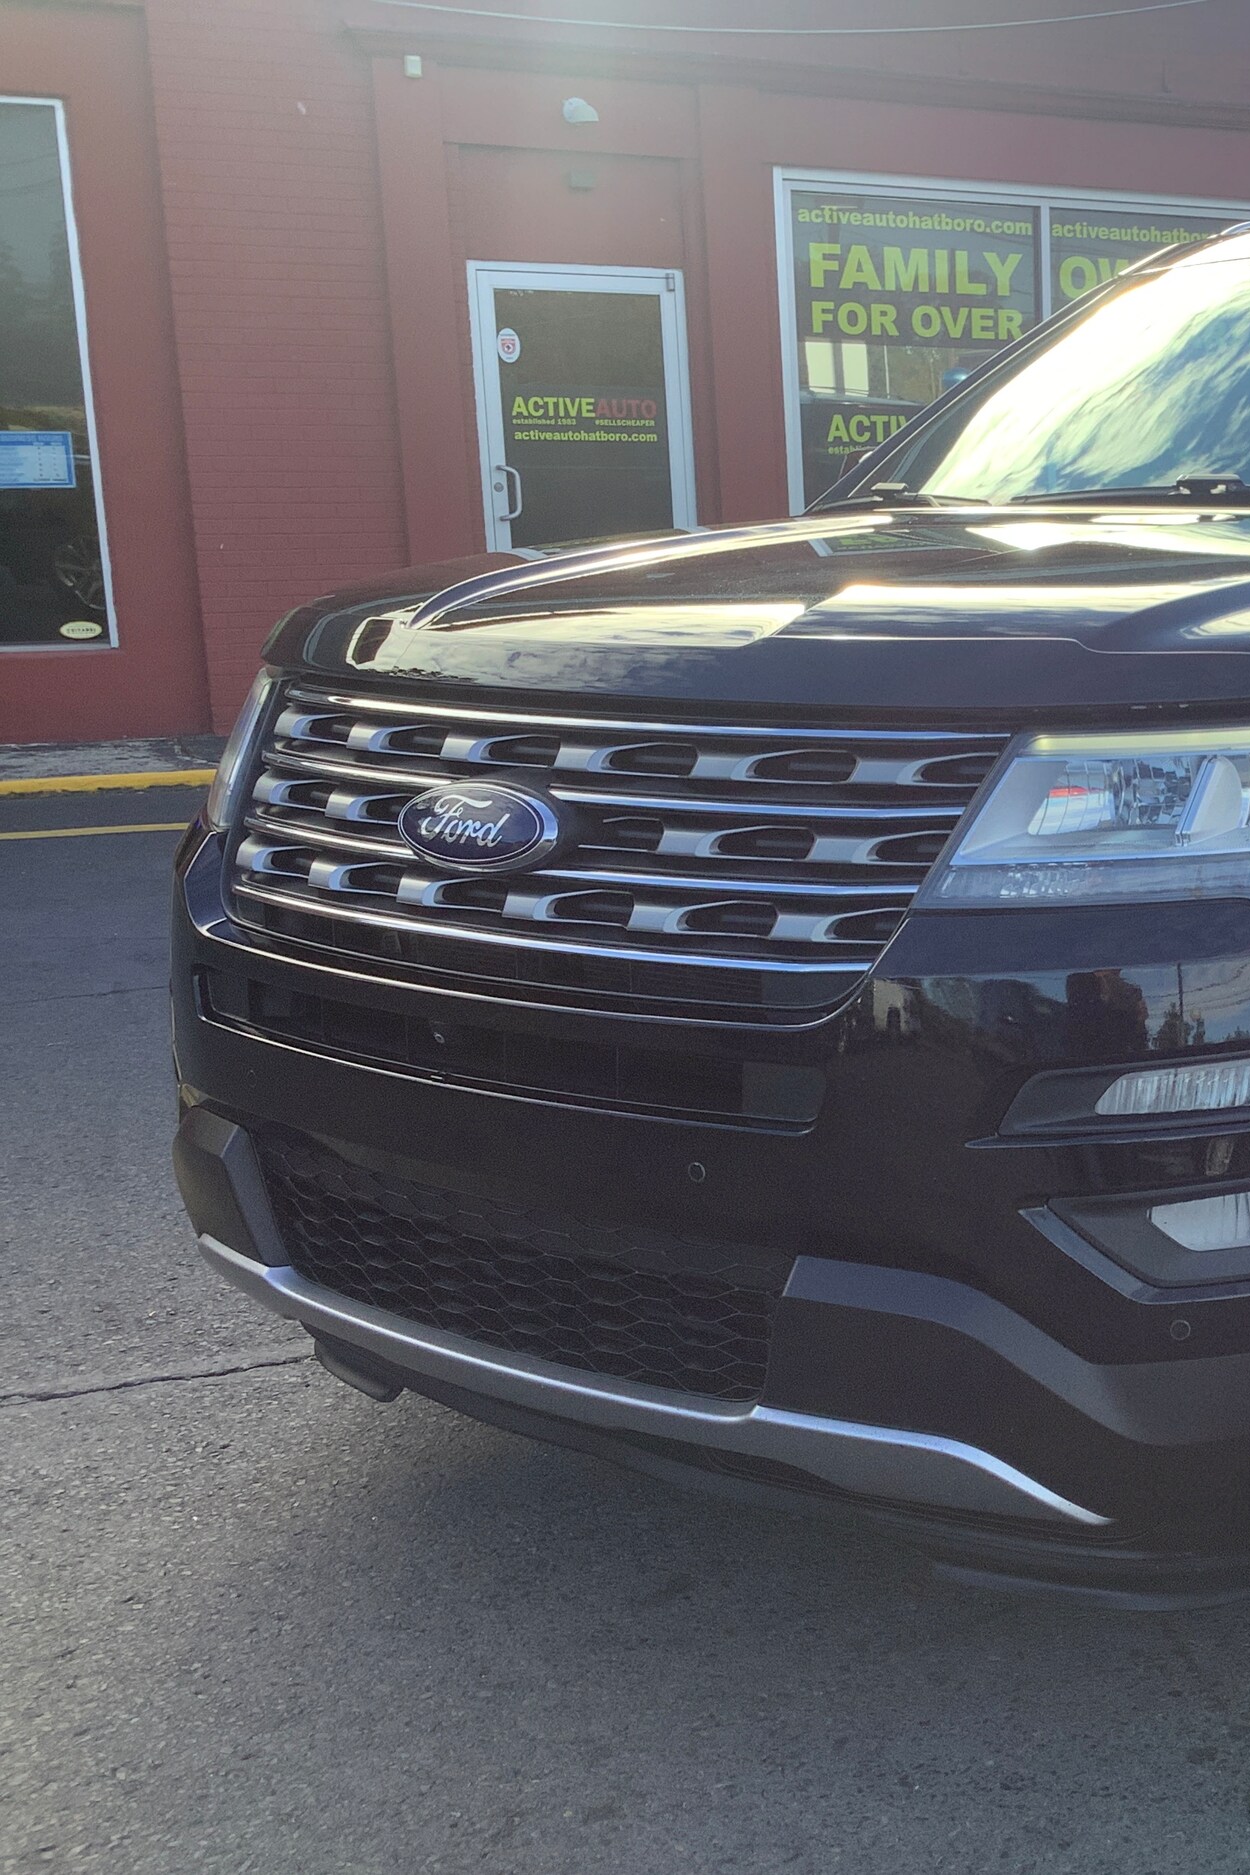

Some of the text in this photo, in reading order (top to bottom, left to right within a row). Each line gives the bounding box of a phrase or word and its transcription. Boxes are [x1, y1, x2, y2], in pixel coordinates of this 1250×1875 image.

[798, 207, 1033, 236] activeautohatboro.com
[809, 242, 1023, 296] FAMILY
[812, 301, 1023, 341] FOR OVER
[514, 430, 658, 442] activeautohatboro.com
[421, 794, 511, 848] Ford
